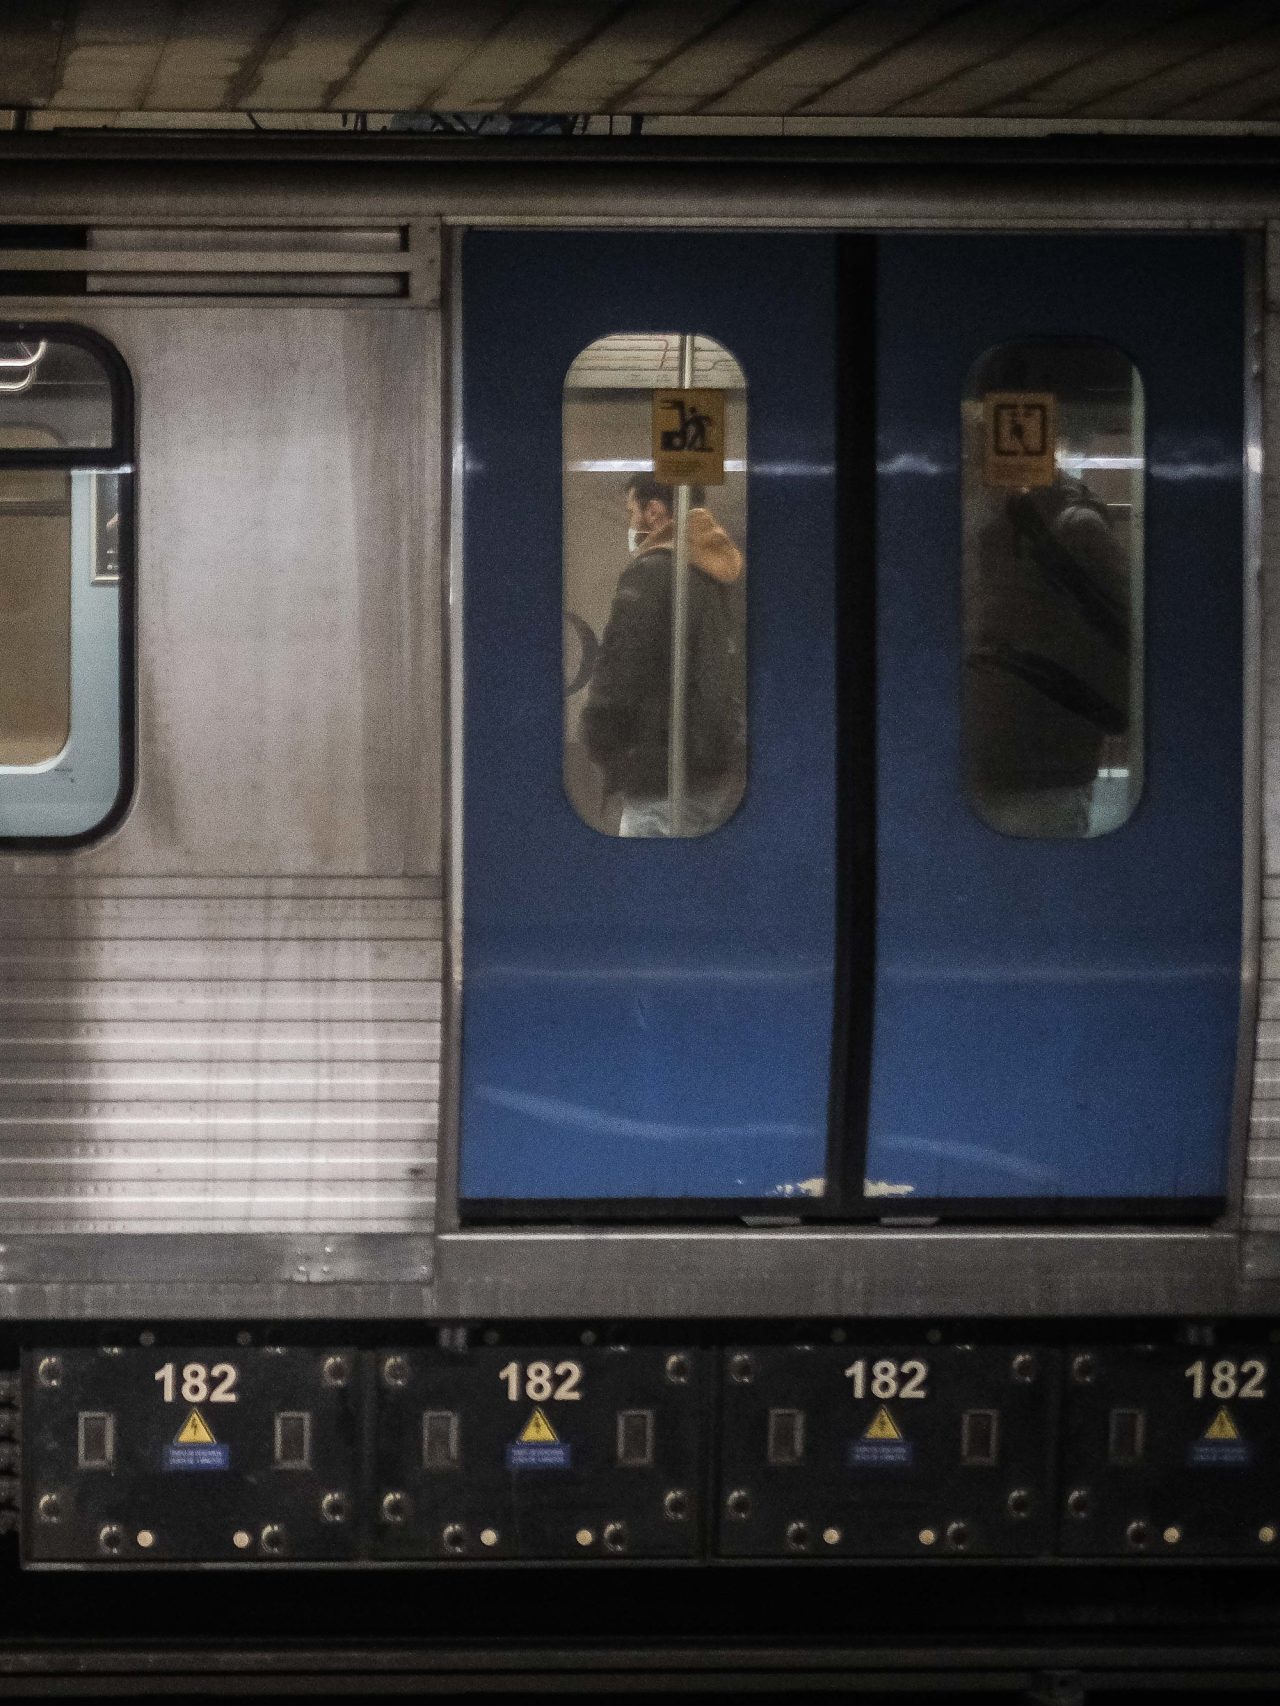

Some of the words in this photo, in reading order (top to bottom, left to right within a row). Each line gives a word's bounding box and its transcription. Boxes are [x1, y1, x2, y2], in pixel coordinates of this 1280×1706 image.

[154, 1362, 238, 1402] 182
[498, 1361, 582, 1401] 182
[843, 1360, 928, 1399] 182
[1184, 1360, 1266, 1399] 182
